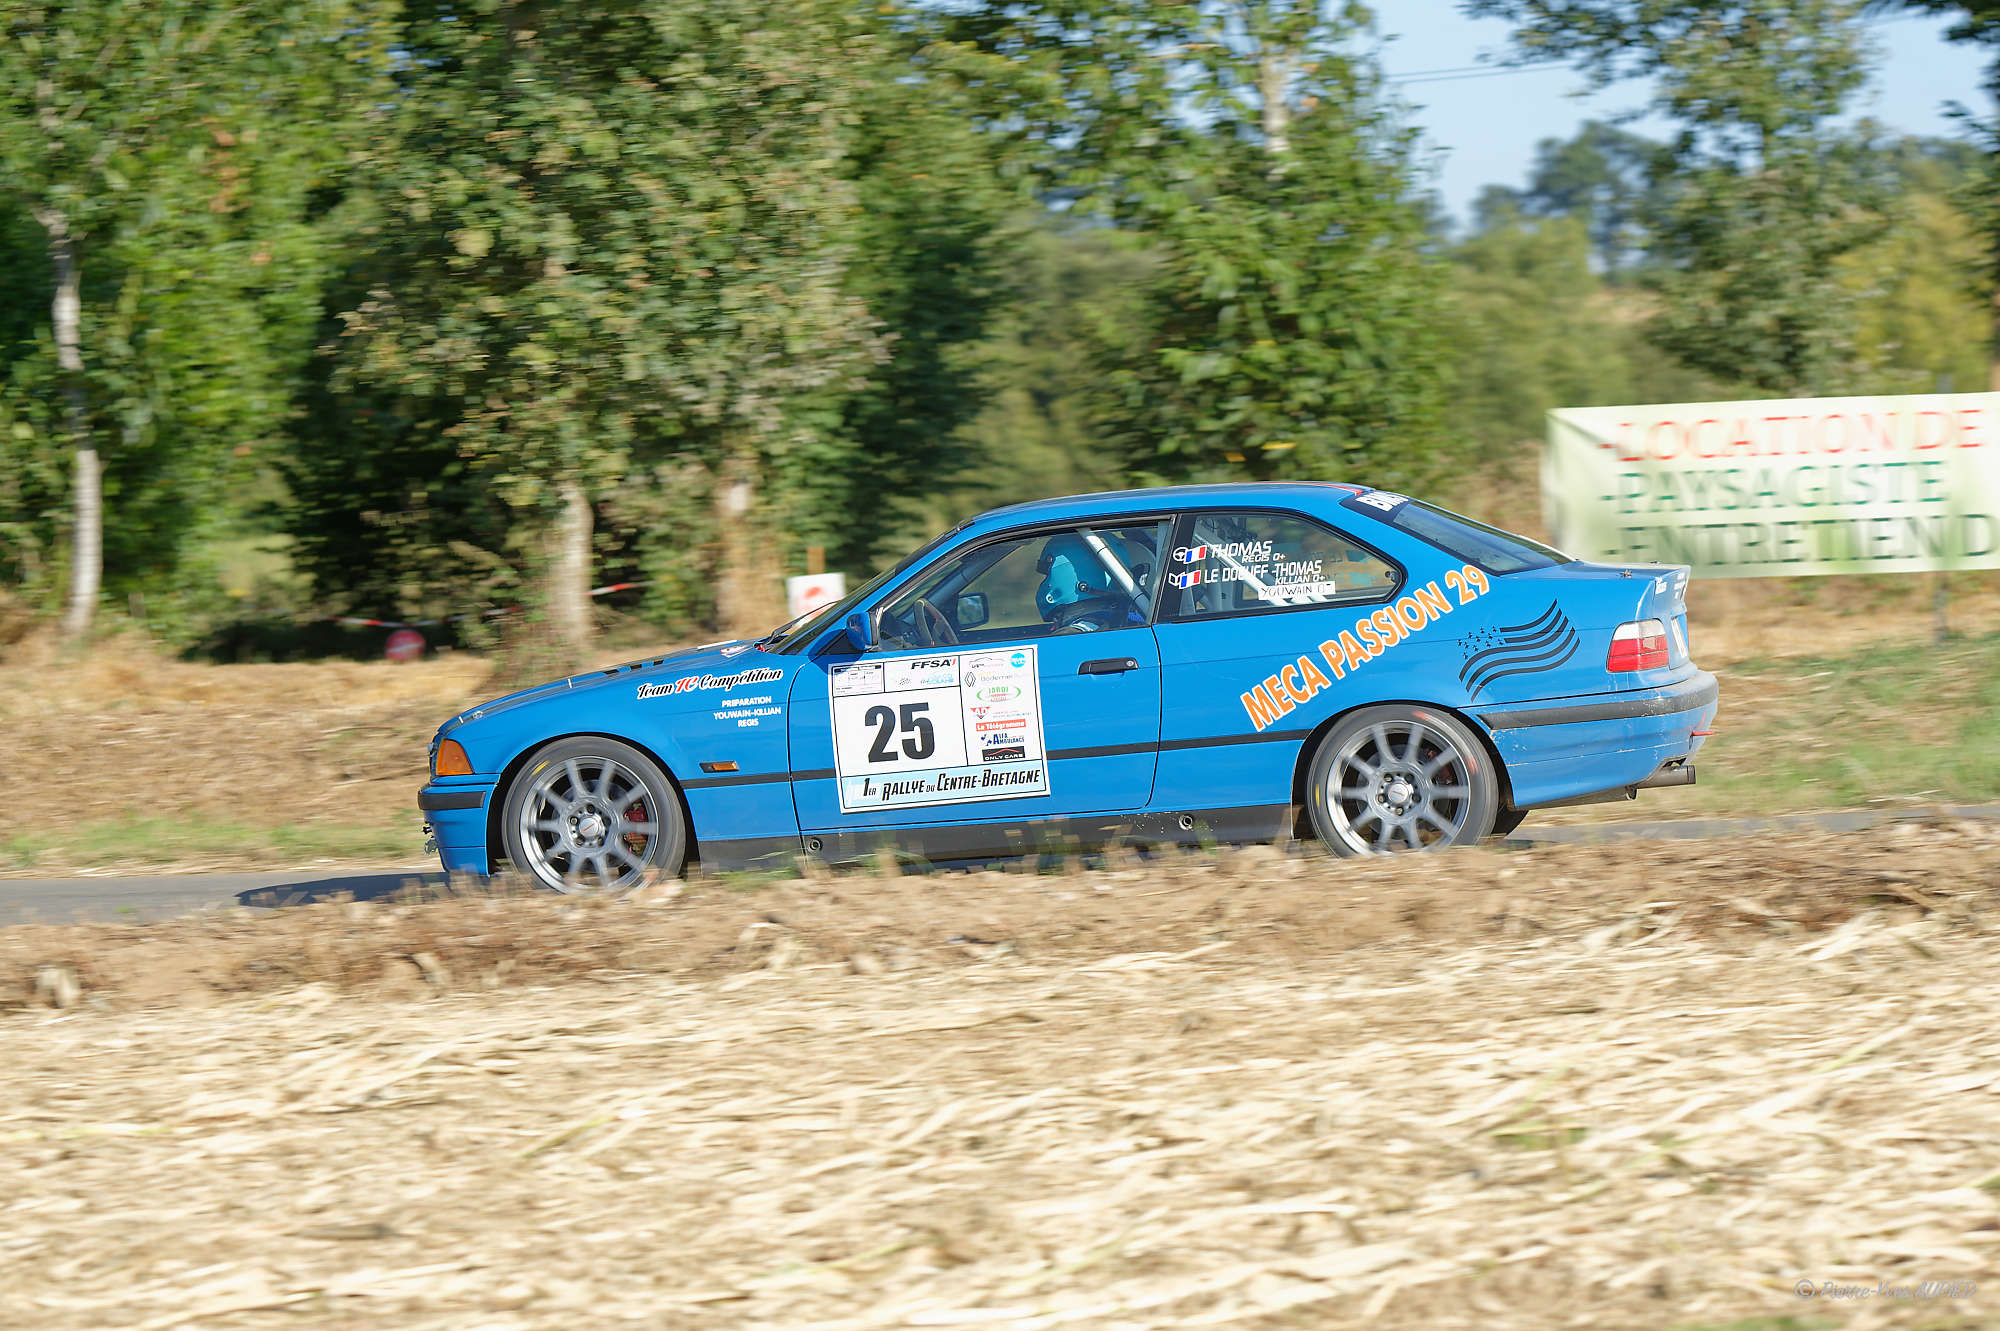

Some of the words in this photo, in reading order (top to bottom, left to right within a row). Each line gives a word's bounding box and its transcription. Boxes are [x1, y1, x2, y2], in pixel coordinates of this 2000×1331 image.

[1617, 412, 1897, 462] LOCATION
[1911, 409, 1984, 450] DE
[1617, 461, 1946, 514] PAYSAGISTE
[1617, 514, 1945, 567] ENTRETIEN
[1211, 540, 1273, 558] THOMAS
[1242, 553, 1270, 563] REGIS
[1204, 568, 1219, 583] LE
[1275, 575, 1310, 585] KILLIAN
[1240, 654, 1331, 732] MECA
[1318, 581, 1453, 680] PASSION
[1445, 565, 1490, 605] 29
[911, 659, 951, 669] FFSA
[638, 684, 673, 698] Team
[722, 696, 772, 707] PREPARATION
[713, 707, 781, 720] YOUWAIN-KILLIAN
[738, 718, 759, 727] REGIS
[864, 702, 936, 764] 25
[882, 780, 926, 801] RALLYE
[925, 784, 936, 793] DU
[936, 768, 1041, 792] CENTRE-BRETAGNE
